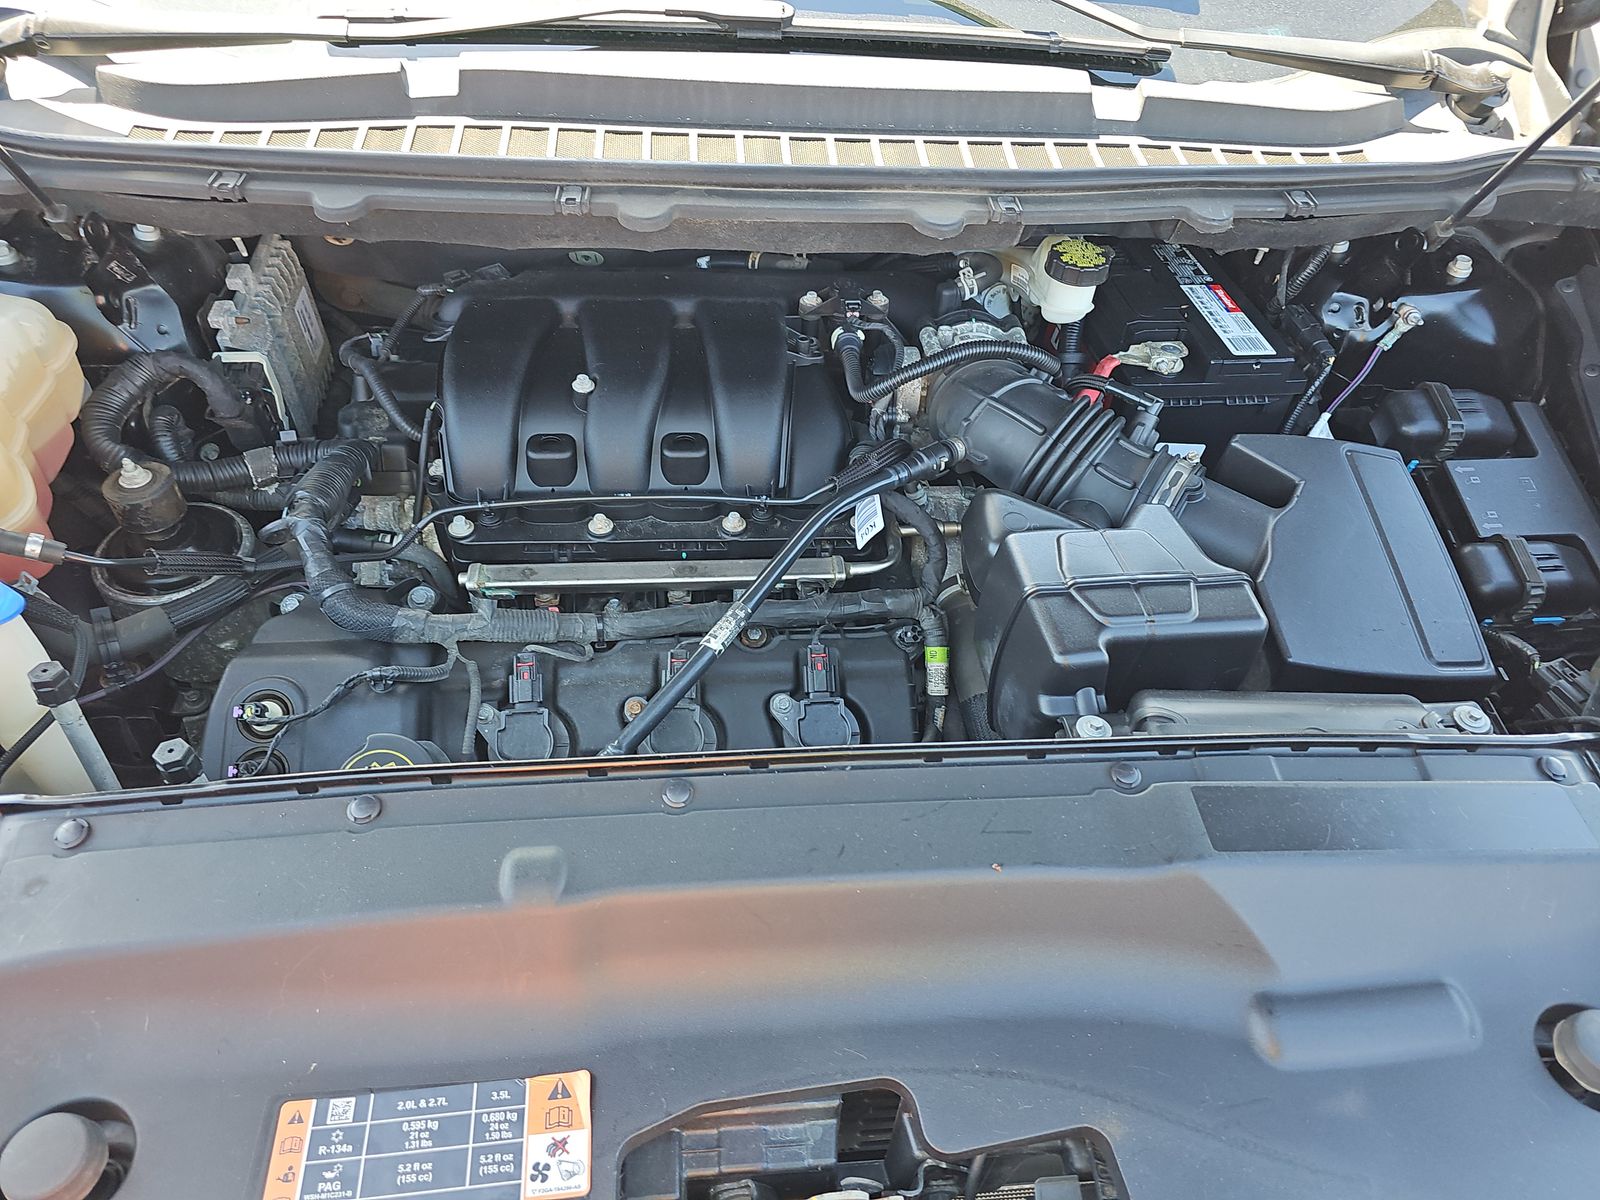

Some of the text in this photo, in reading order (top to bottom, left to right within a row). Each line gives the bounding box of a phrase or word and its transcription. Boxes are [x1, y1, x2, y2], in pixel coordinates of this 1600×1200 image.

[490, 1090, 511, 1101] 3.5L
[396, 1097, 449, 1111] 2.0L & 2.7L
[506, 1112, 518, 1122] kg
[402, 1120, 439, 1132] 0.595 kg
[489, 1122, 499, 1131] 24
[409, 1131, 419, 1139] 21
[501, 1131, 513, 1139] lbs
[318, 1143, 353, 1156] R-134a
[404, 1139, 432, 1150] 1.31 lbs
[479, 1154, 494, 1163] 5.2
[398, 1163, 412, 1173] 5.2
[421, 1162, 433, 1170] oz
[479, 1163, 515, 1177] (155 cc)
[396, 1172, 433, 1186] (155 cc)
[317, 1180, 341, 1193] PAG
